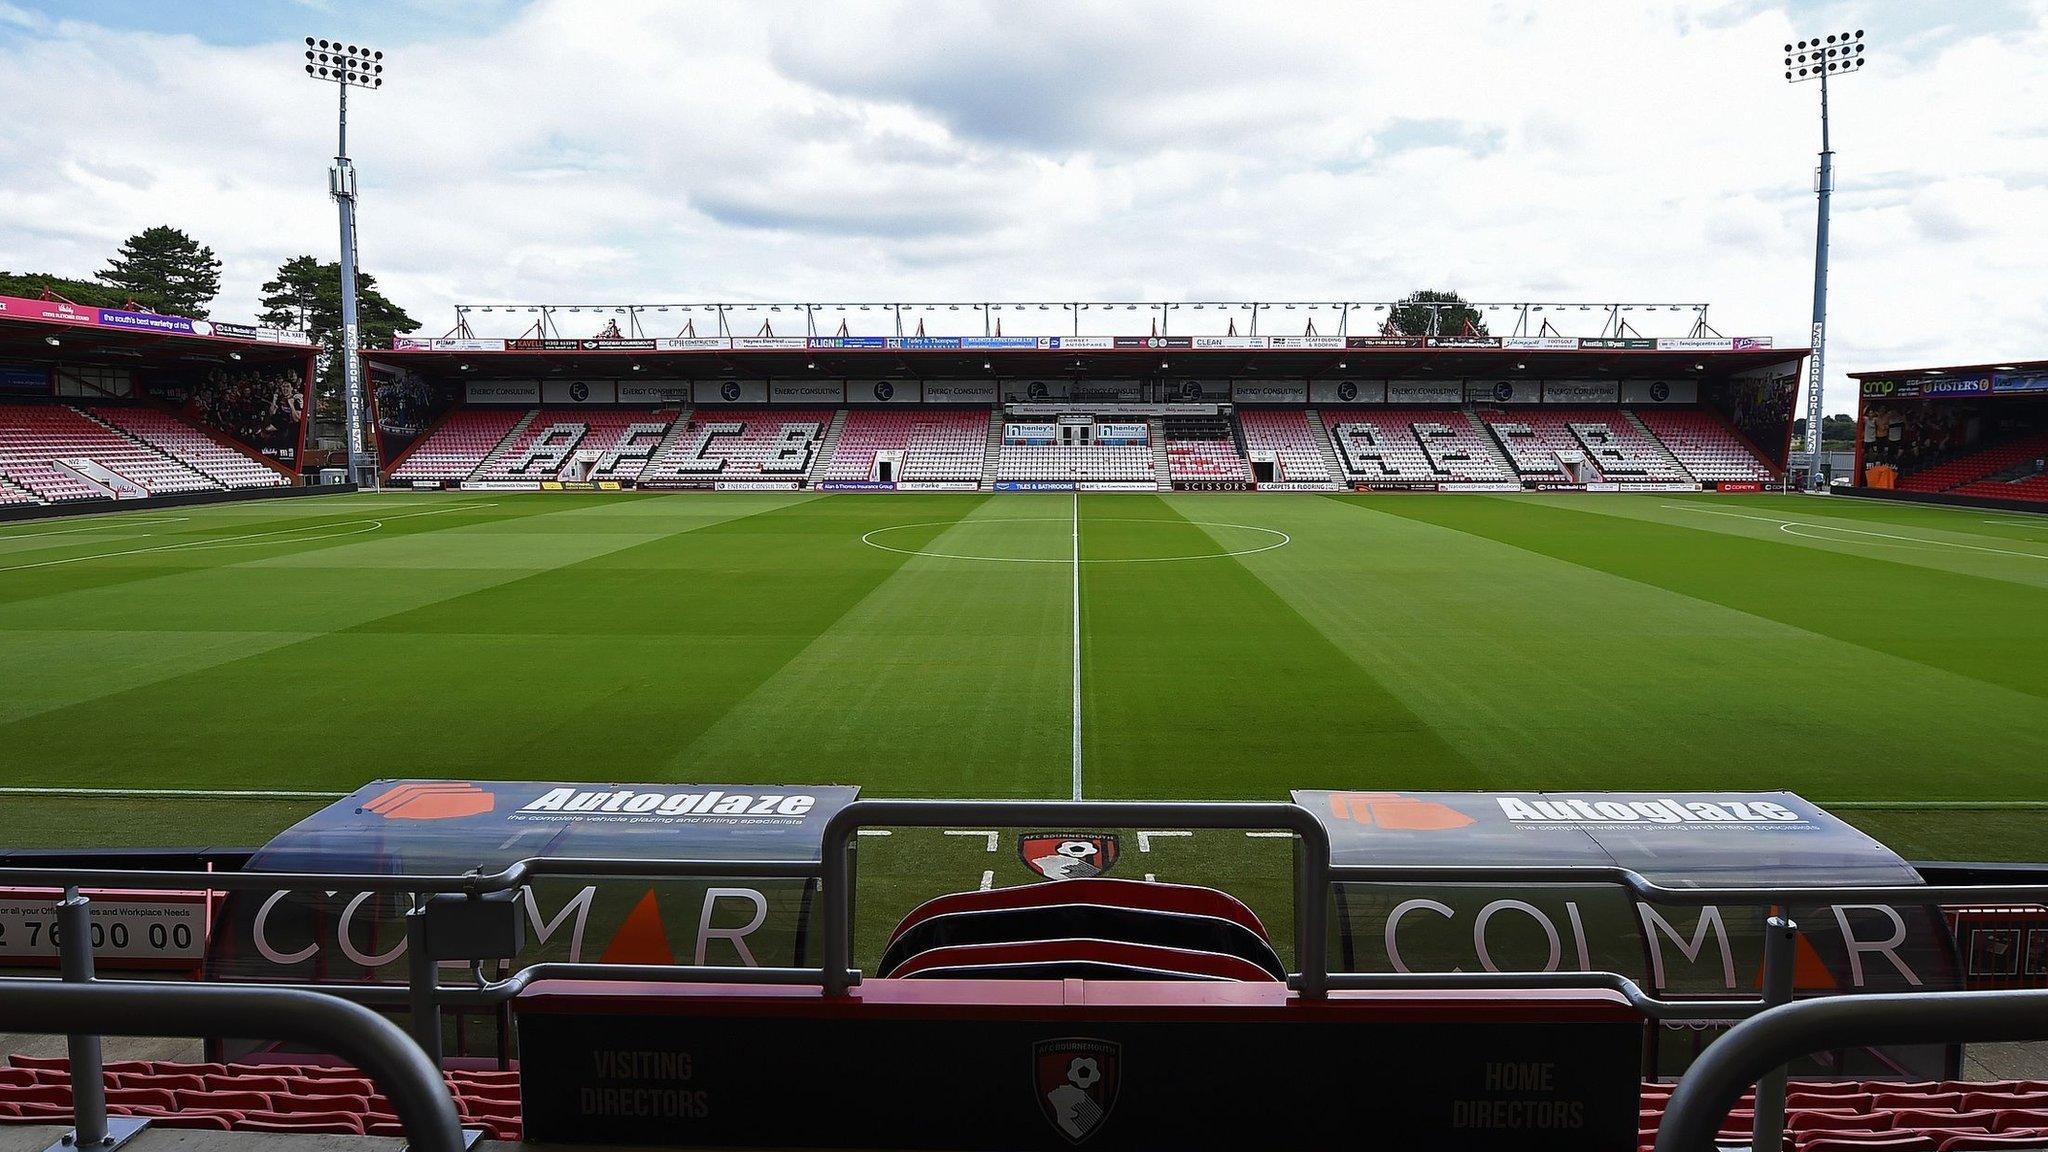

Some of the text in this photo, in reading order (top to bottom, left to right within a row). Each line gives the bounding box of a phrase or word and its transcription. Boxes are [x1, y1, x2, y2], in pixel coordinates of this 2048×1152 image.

[103, 313, 114, 322] the
[136, 317, 149, 325] best
[150, 319, 173, 330] variety
[180, 322, 190, 330] hits
[809, 339, 834, 348] ALIGN
[350, 350, 360, 429] LABORATORIES
[470, 387, 535, 395] ENERGY CONSULTING
[774, 387, 840, 395] ENERGY CONSULTING
[928, 387, 993, 395] ENERGY CONSULTING
[1237, 387, 1303, 395] ENERGY CONSULTING
[1392, 387, 1458, 395] ENERGY CONSULTING
[1547, 387, 1614, 395] ENERGY CONSULTING
[1809, 348, 1820, 429] LABORATORIES
[1863, 381, 1894, 396] cmp
[1933, 380, 1979, 392] FOSTER'S
[1184, 483, 1247, 491] SCISSORS
[522, 787, 816, 816] Autoglaze
[1496, 797, 1799, 824] Autoglaze
[528, 815, 584, 823] complete
[630, 816, 674, 825] glazing
[702, 817, 739, 825] tinting
[740, 818, 803, 826] specialists
[1043, 833, 1114, 841] BOURNEMOUTH
[10, 907, 20, 915] all
[21, 908, 40, 917] your
[102, 908, 118, 916] and
[119, 908, 163, 918] Workplace
[164, 908, 191, 917] Needs
[253, 886, 769, 968] COMAR
[148, 923, 192, 949] 00
[1056, 1042, 1116, 1054] BOURNEMOUTH
[592, 1050, 693, 1080] VISITING
[1485, 1061, 1554, 1092] HOME
[580, 1087, 710, 1119] DIRECTORS
[1453, 1100, 1585, 1129] DIRECTORS
